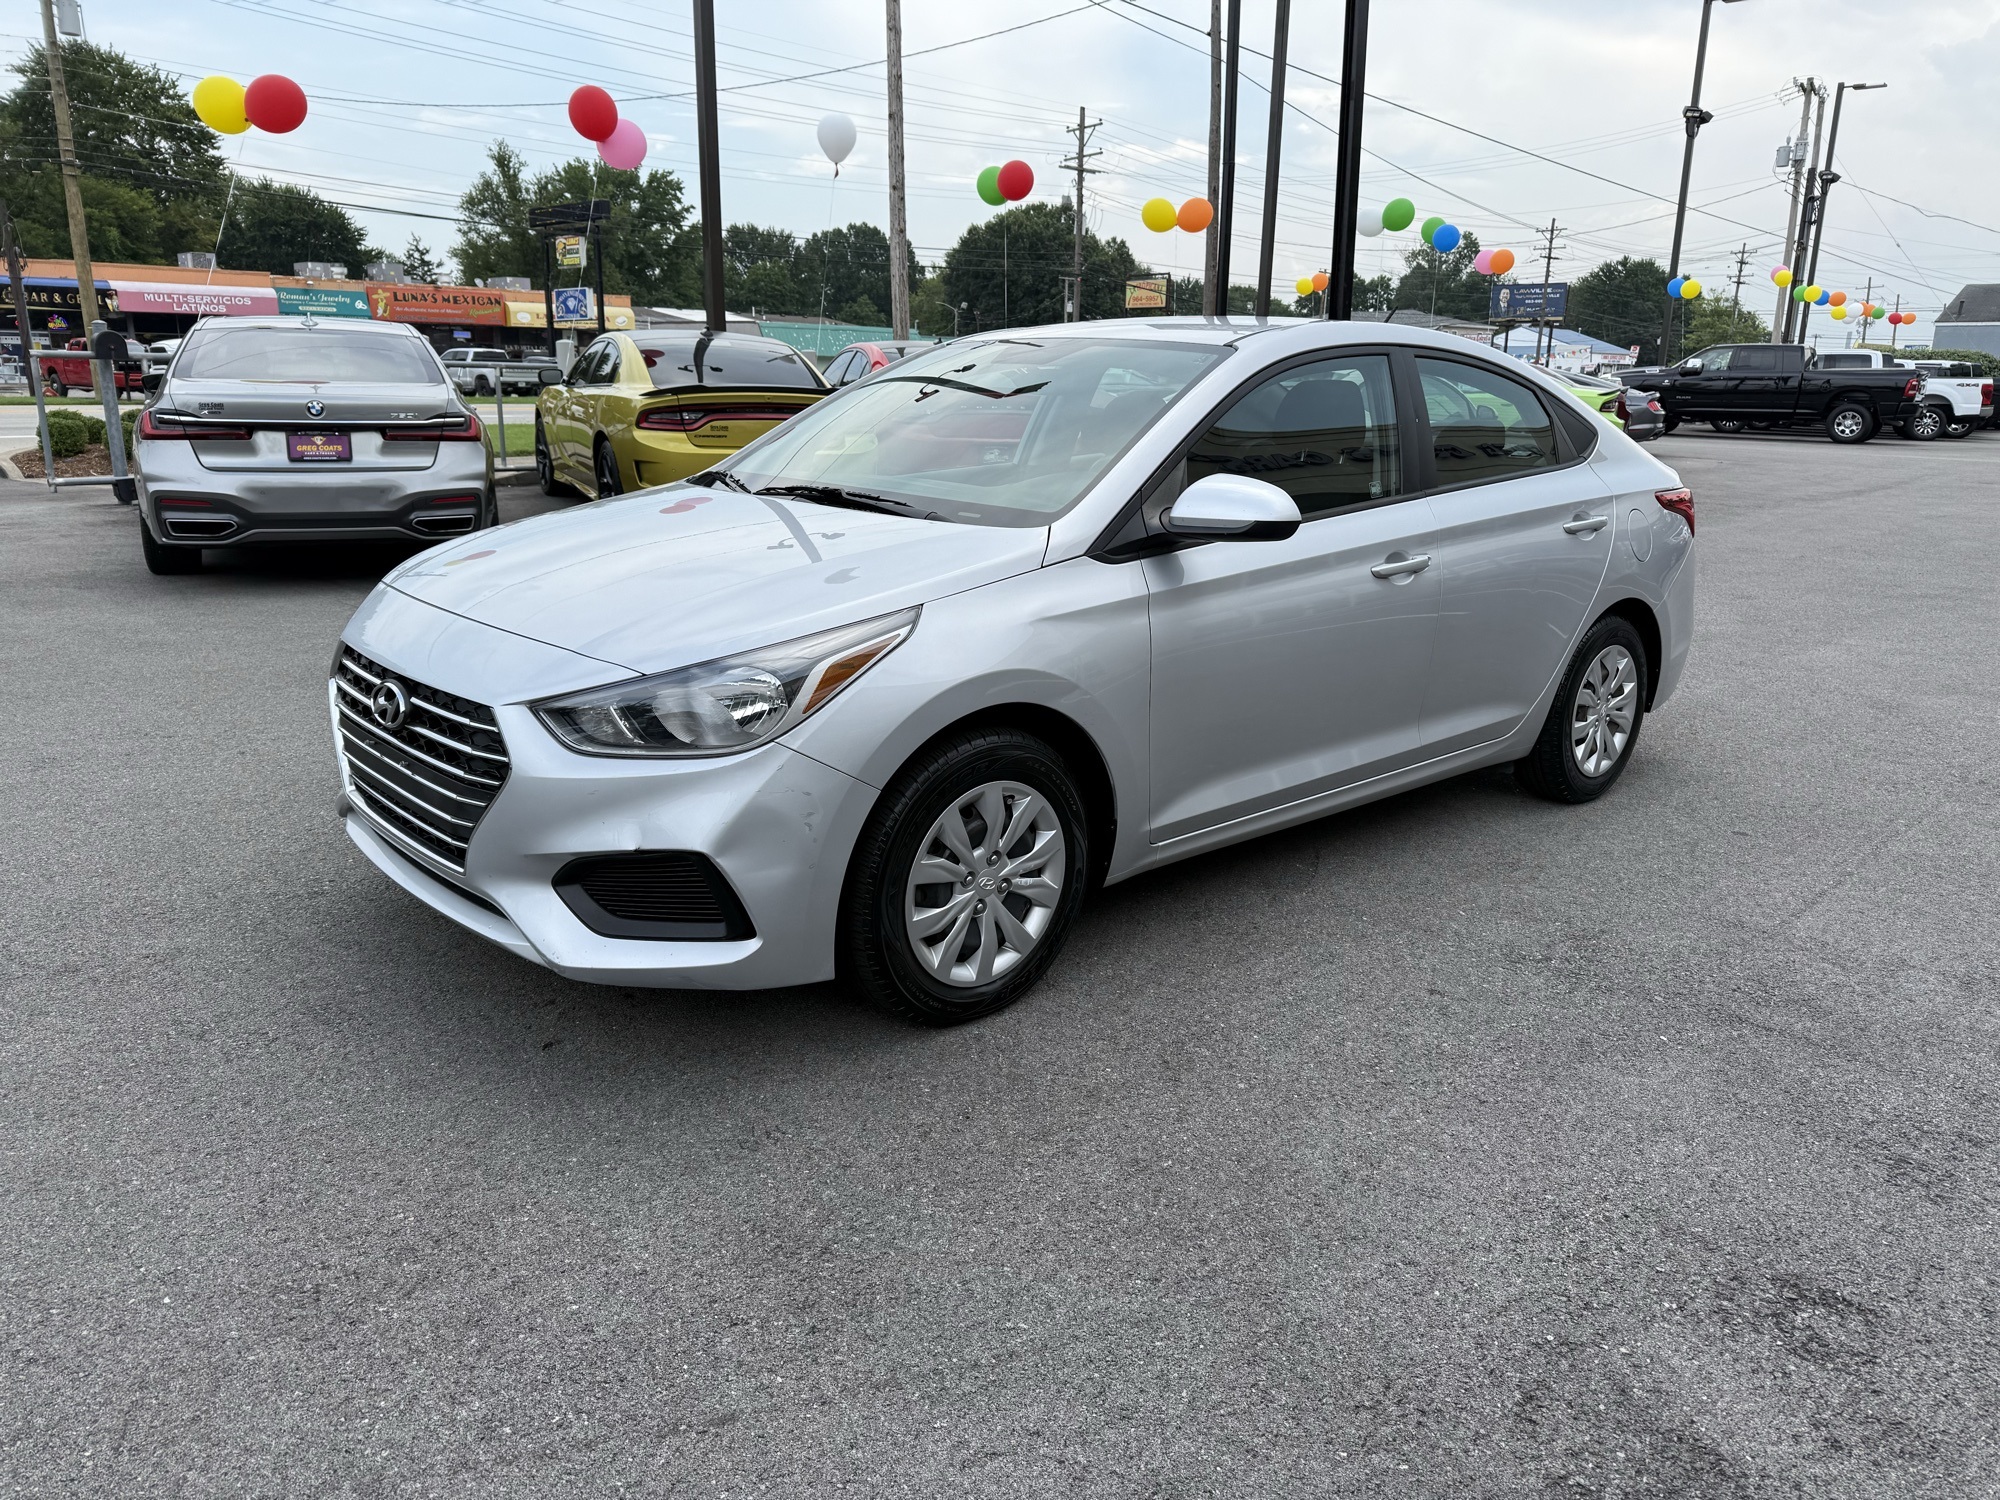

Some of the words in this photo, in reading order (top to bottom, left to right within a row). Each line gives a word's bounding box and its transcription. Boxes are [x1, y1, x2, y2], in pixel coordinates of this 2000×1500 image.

[23, 291, 48, 303] BAR
[53, 292, 62, 304] &
[144, 293, 251, 305] MULTI-SERVICIOS
[278, 291, 316, 301] Roman's
[318, 293, 350, 304] Jewelry
[393, 291, 438, 304] LUNA'S
[441, 293, 502, 307] MEXICAN
[173, 303, 226, 313] LATINOS
